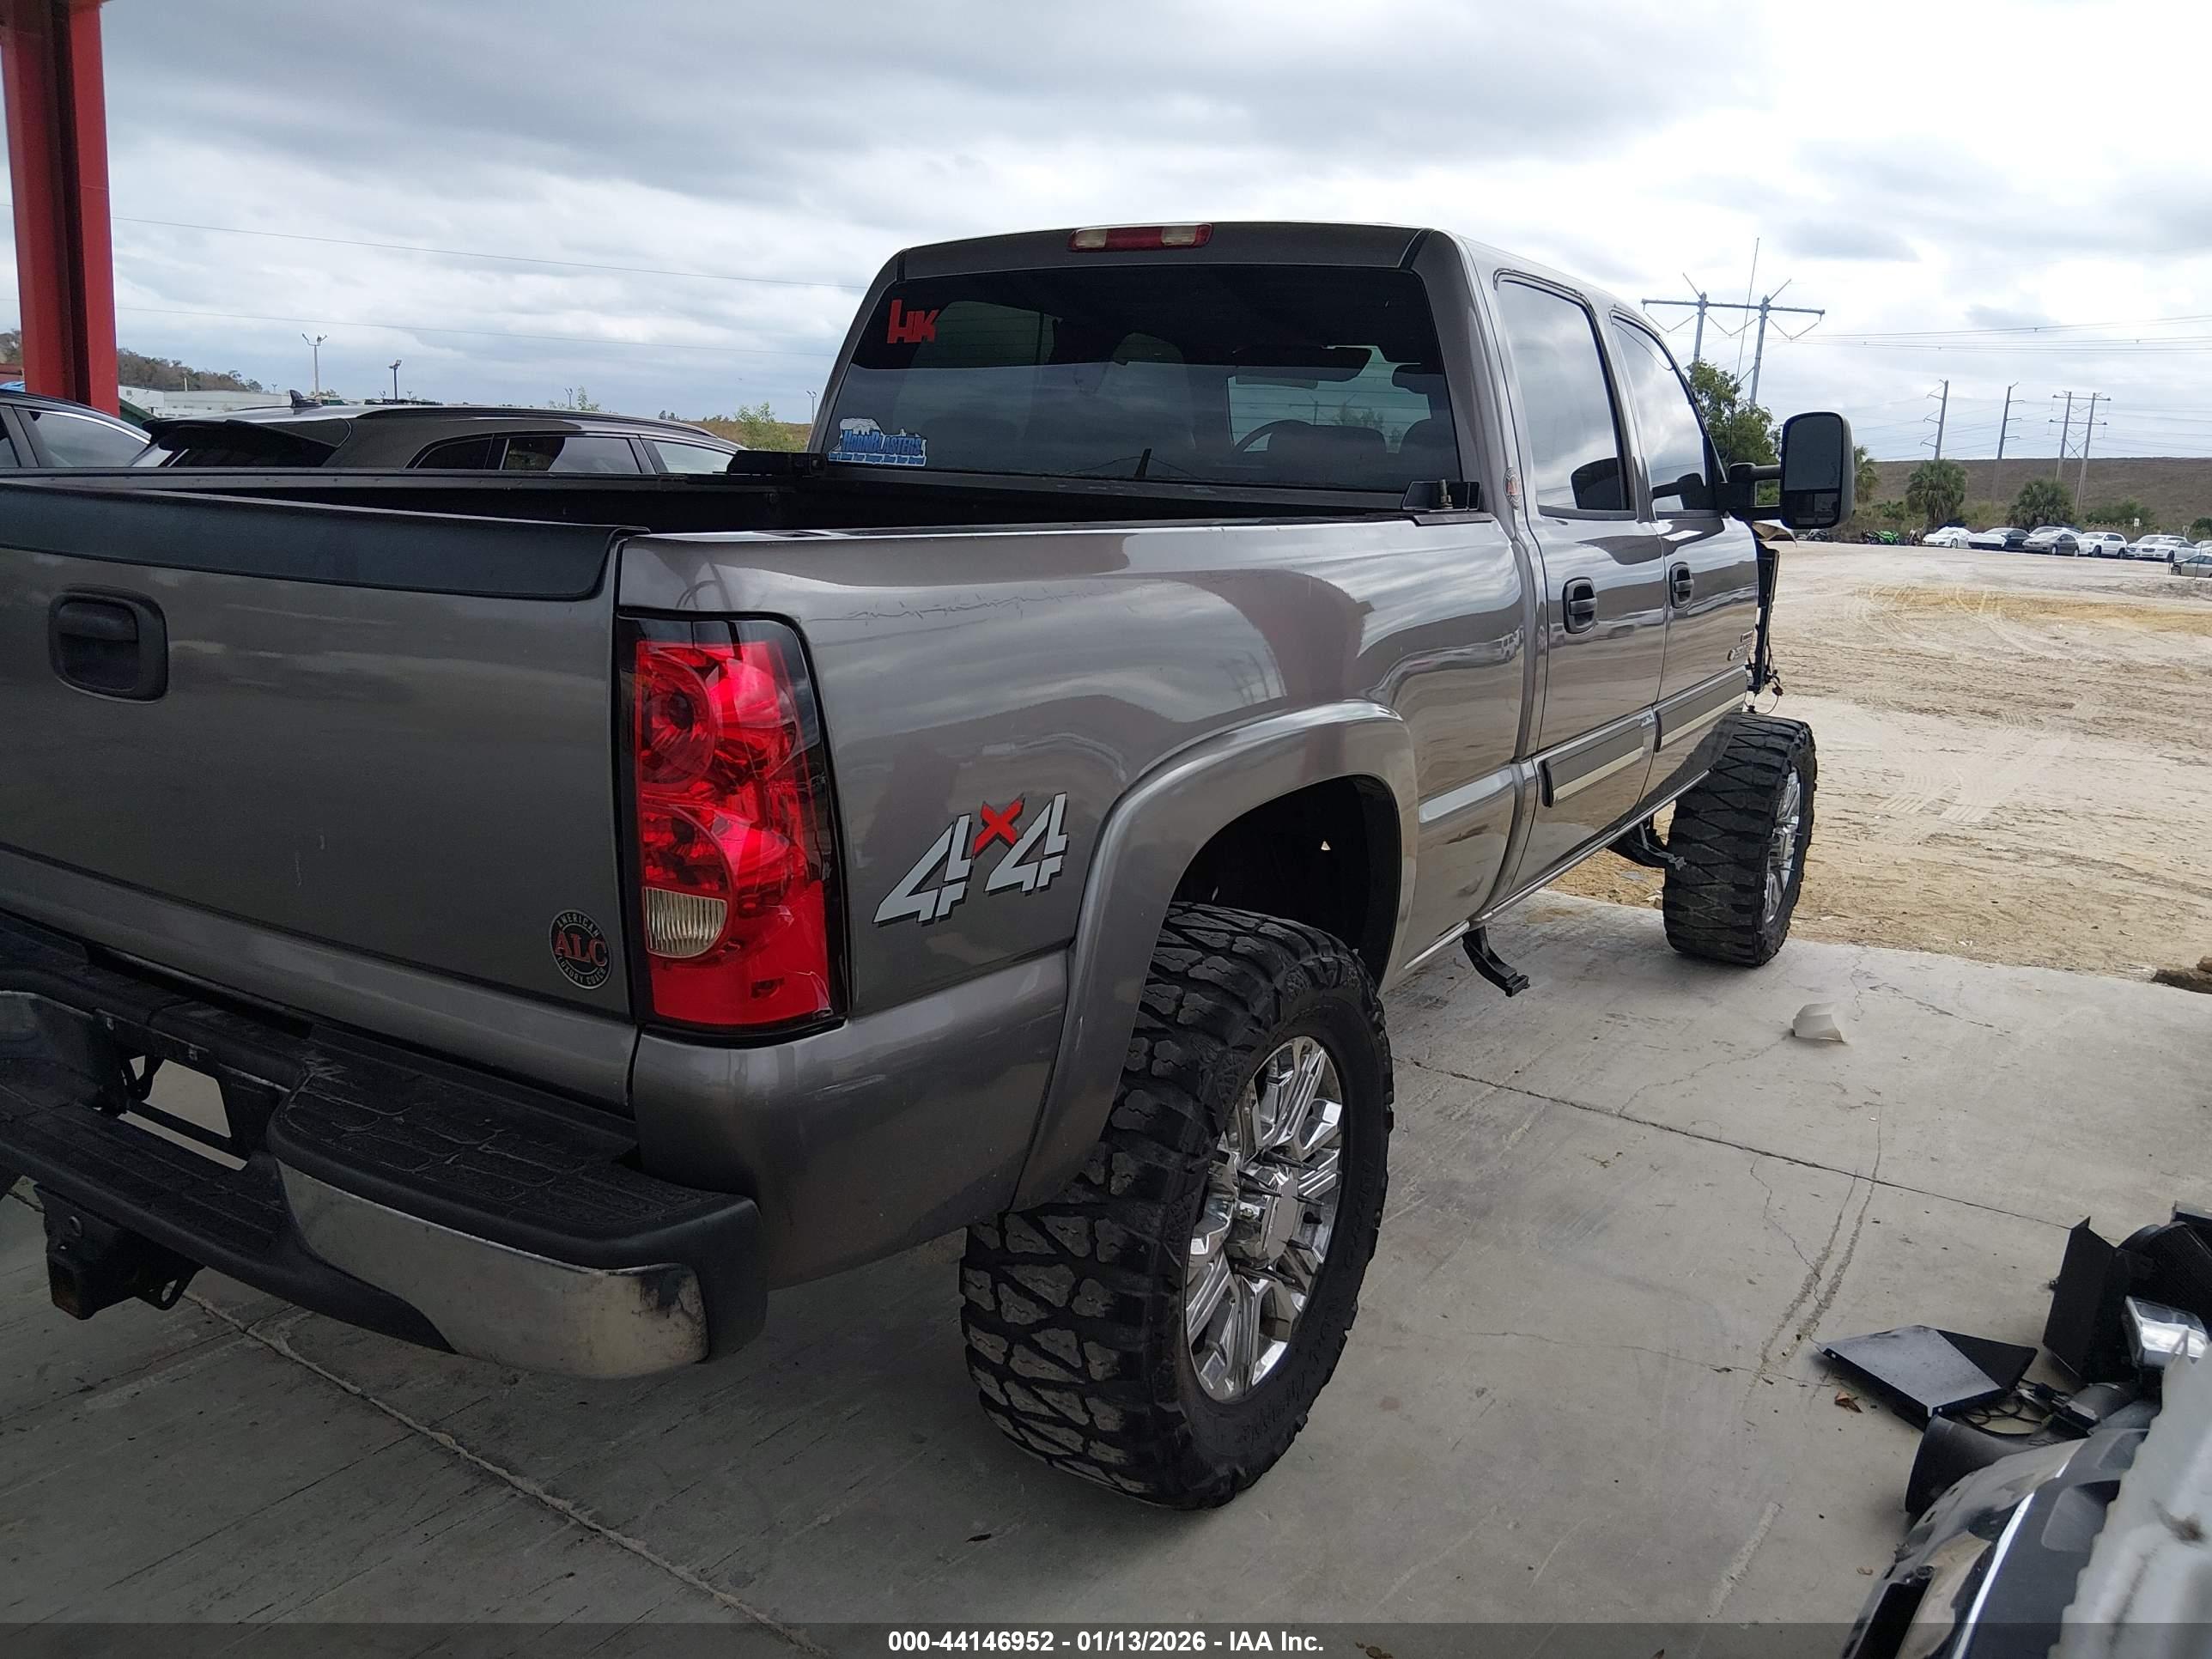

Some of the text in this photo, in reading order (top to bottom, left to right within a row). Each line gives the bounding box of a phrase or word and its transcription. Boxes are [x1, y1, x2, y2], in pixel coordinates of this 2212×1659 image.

[887, 299, 939, 343] HK
[556, 913, 600, 938] AMERICAN
[554, 929, 608, 967] ALC
[557, 957, 584, 983] LUXURY
